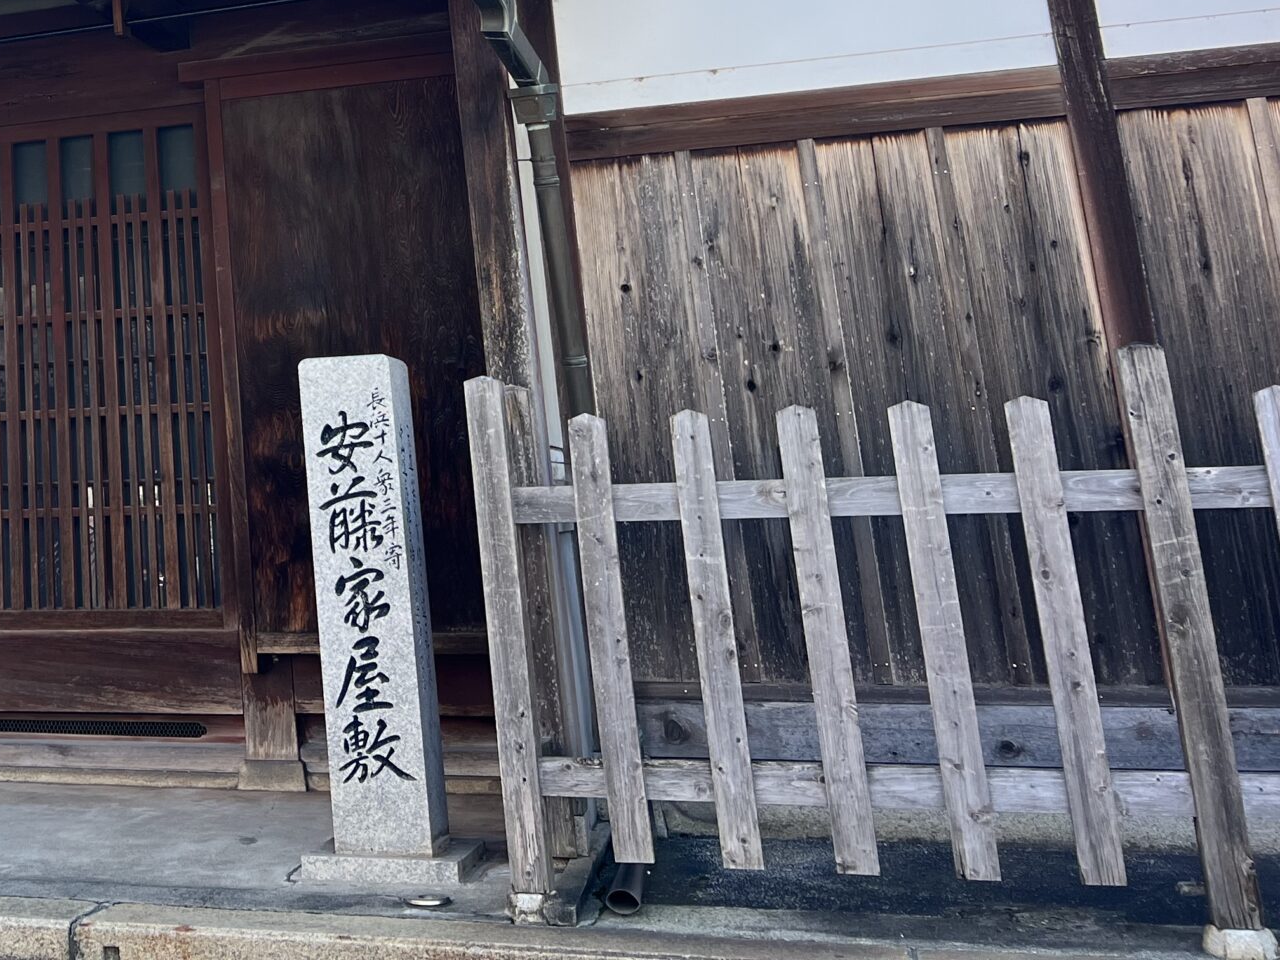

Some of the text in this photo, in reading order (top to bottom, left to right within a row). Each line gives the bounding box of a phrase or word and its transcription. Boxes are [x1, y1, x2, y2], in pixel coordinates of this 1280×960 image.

[316, 410, 417, 784] 安藤家屋敷
